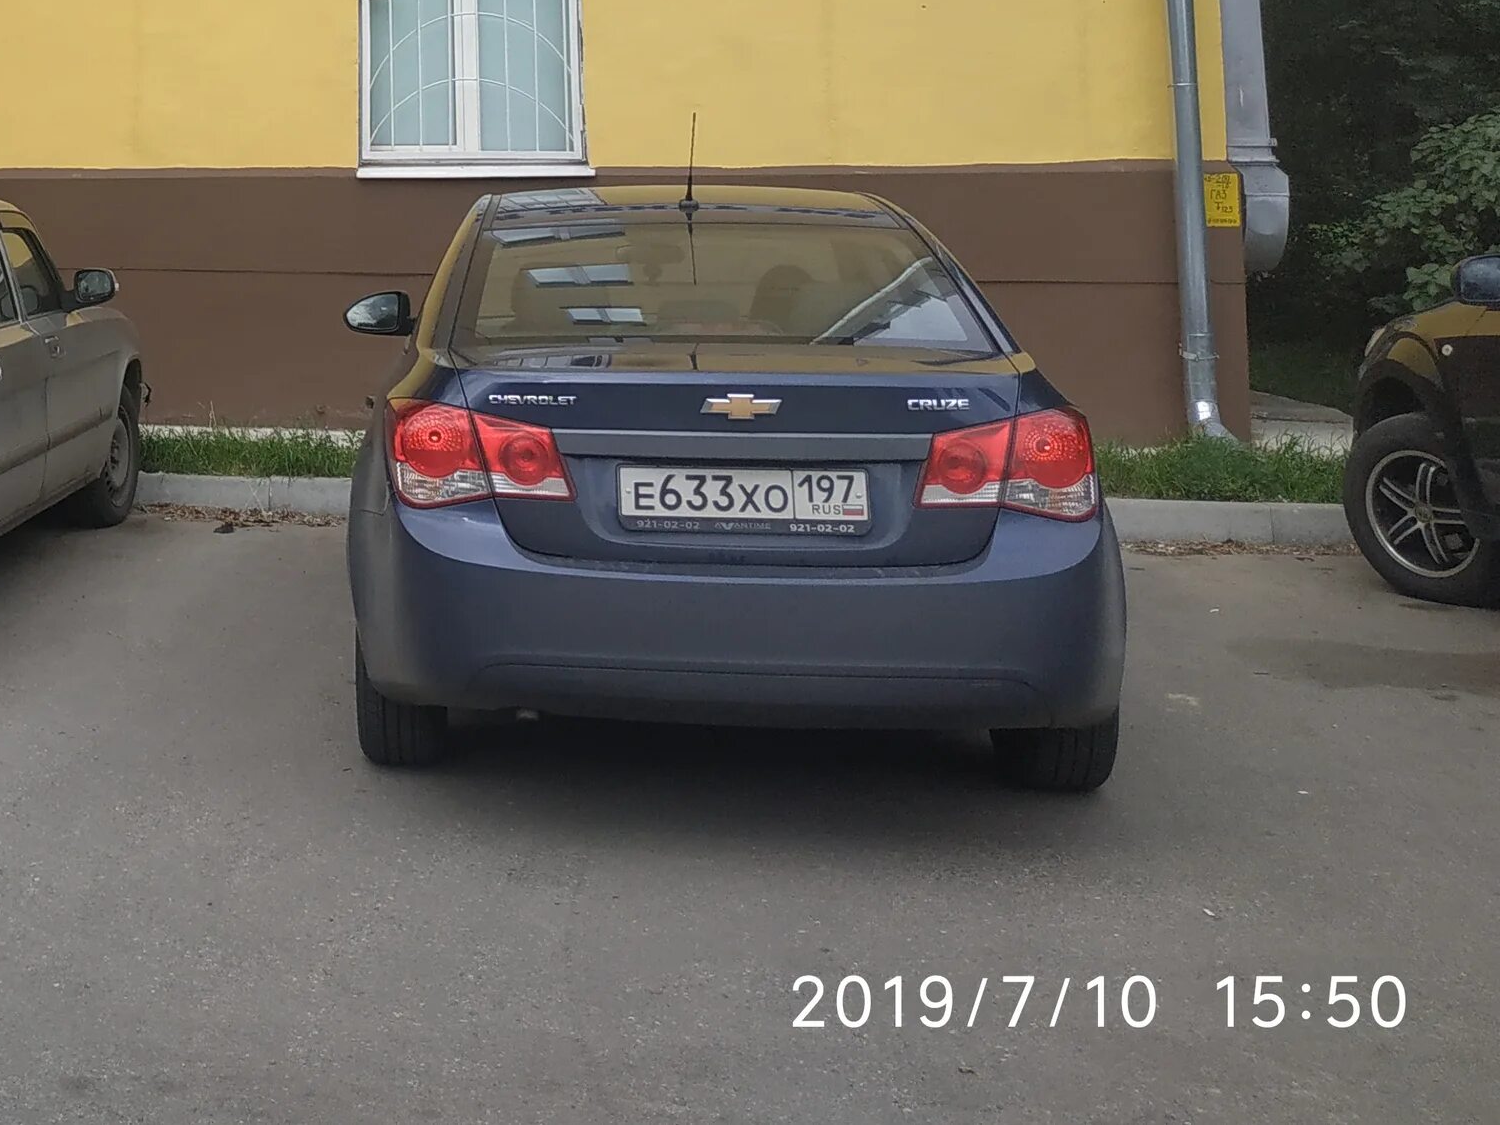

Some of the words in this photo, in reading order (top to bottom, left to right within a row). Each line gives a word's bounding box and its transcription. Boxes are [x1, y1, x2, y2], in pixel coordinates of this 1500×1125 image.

[488, 394, 578, 406] CHEVROLET
[906, 398, 971, 411] CRUZE
[812, 504, 841, 515] RUS
[636, 519, 700, 529] 921-02-02
[789, 523, 855, 533] 921-02-02
